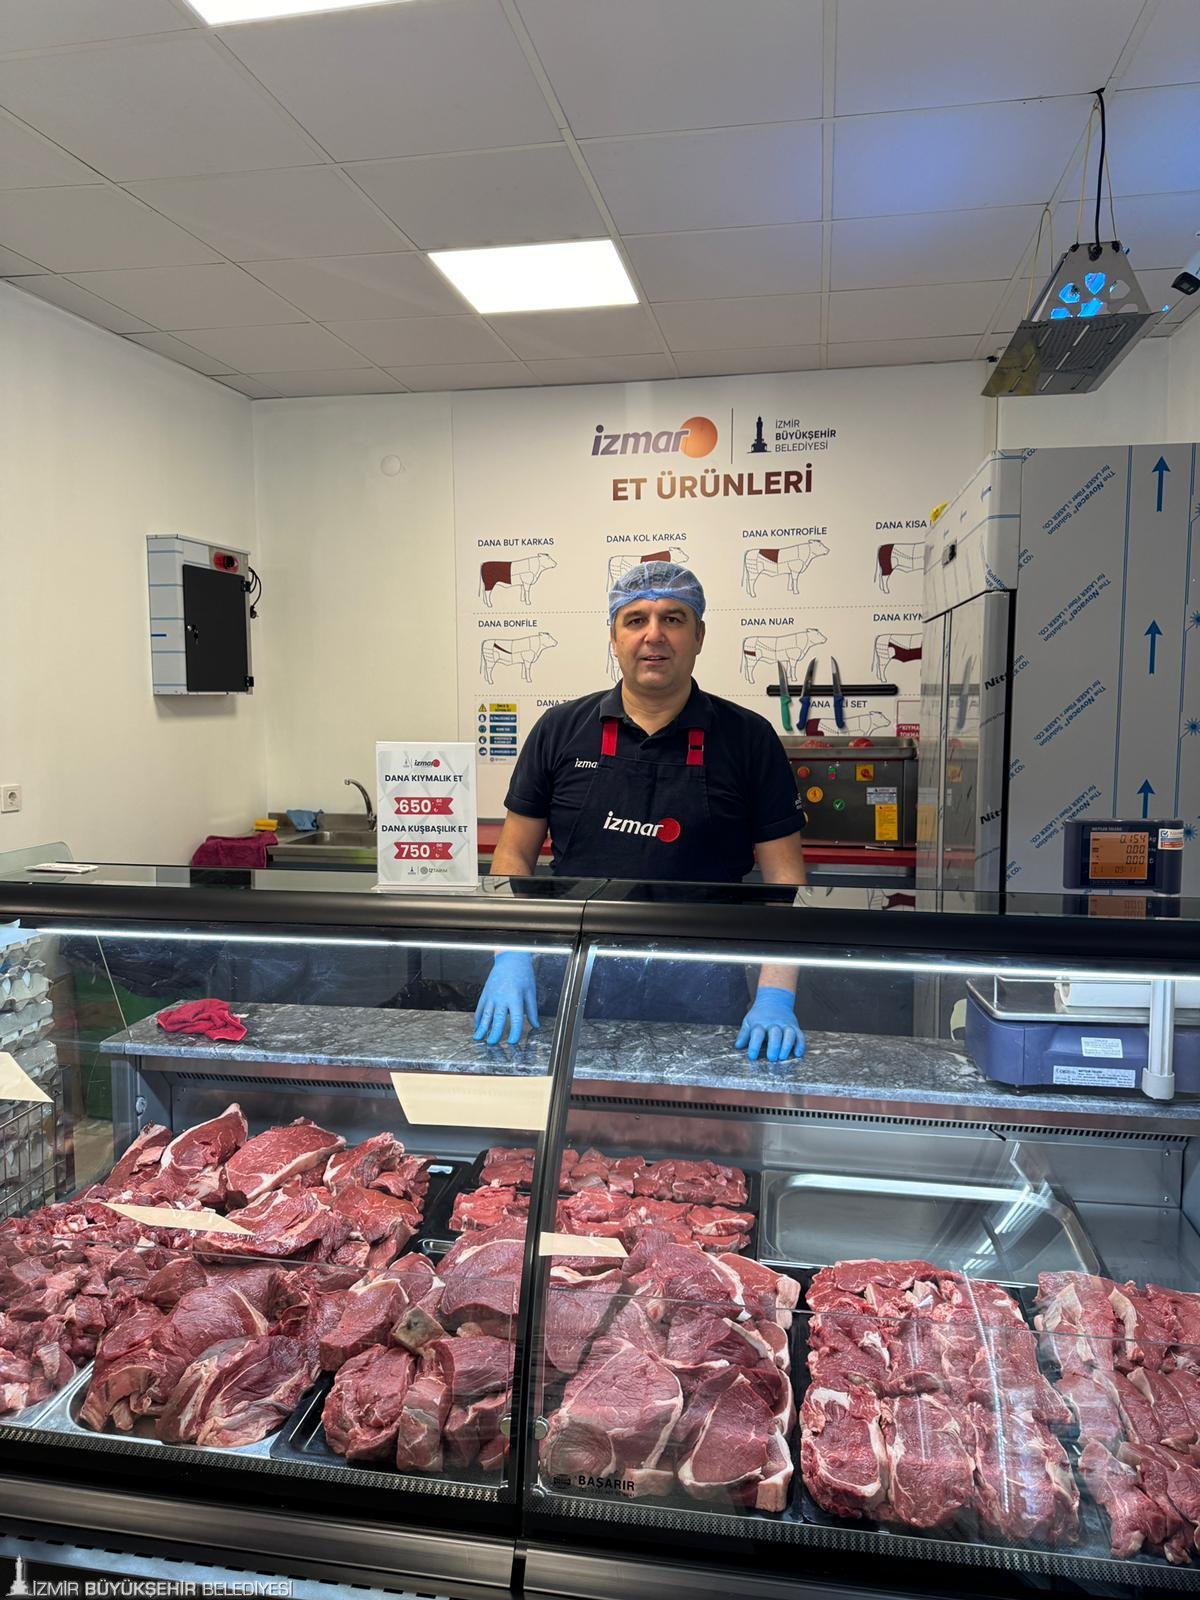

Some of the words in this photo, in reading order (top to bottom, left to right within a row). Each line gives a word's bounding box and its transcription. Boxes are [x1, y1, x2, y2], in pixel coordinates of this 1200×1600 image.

[775, 418, 800, 429] İZMİR
[591, 424, 689, 456] izmar
[775, 428, 836, 441] BÜYÜKŞEHİR
[775, 440, 828, 452] BELEDİYESİ
[612, 477, 647, 501] ET
[657, 463, 812, 500] ÜRÜNLERİ
[876, 521, 903, 530] DANA
[905, 520, 927, 528] KISA
[742, 530, 769, 538] DANA
[770, 526, 828, 537] KONTROFİLE
[477, 539, 502, 547] DANA
[503, 538, 519, 546] BUT
[521, 538, 554, 546] KARKAS
[606, 535, 631, 543] DANA
[633, 534, 650, 542] KOL
[652, 533, 687, 542] KARKAS
[740, 618, 766, 626] DANA
[873, 613, 901, 621] DANA
[478, 620, 502, 628] DANA
[503, 619, 538, 628] BONFİLE
[984, 673, 1007, 690] Nit
[810, 700, 830, 708] ANA
[851, 700, 868, 708] SET
[574, 758, 598, 768] izma
[400, 799, 431, 813] 650
[980, 808, 1002, 824] Nit
[603, 810, 664, 837] izmar
[408, 825, 456, 834] KUŞBAŞILIK
[400, 844, 430, 858] 750
